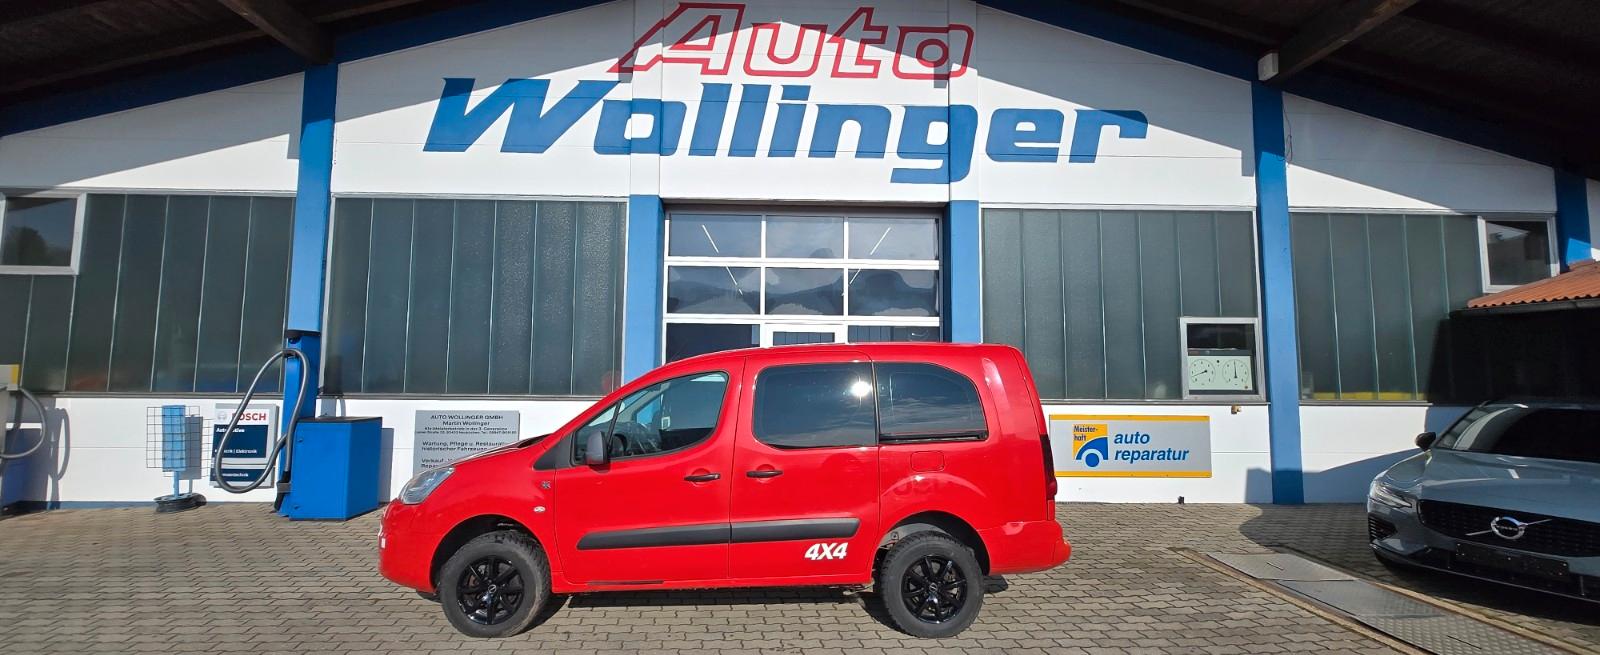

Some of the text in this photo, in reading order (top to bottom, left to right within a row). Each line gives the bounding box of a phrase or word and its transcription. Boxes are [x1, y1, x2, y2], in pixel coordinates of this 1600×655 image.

[607, 2, 975, 80] Auto
[422, 77, 1149, 184] Wollinger
[1073, 425, 1099, 433] Meister-
[1073, 433, 1086, 441] haft
[1114, 431, 1150, 444] auto
[1114, 447, 1189, 464] reparatur
[804, 542, 848, 560] 4X4
